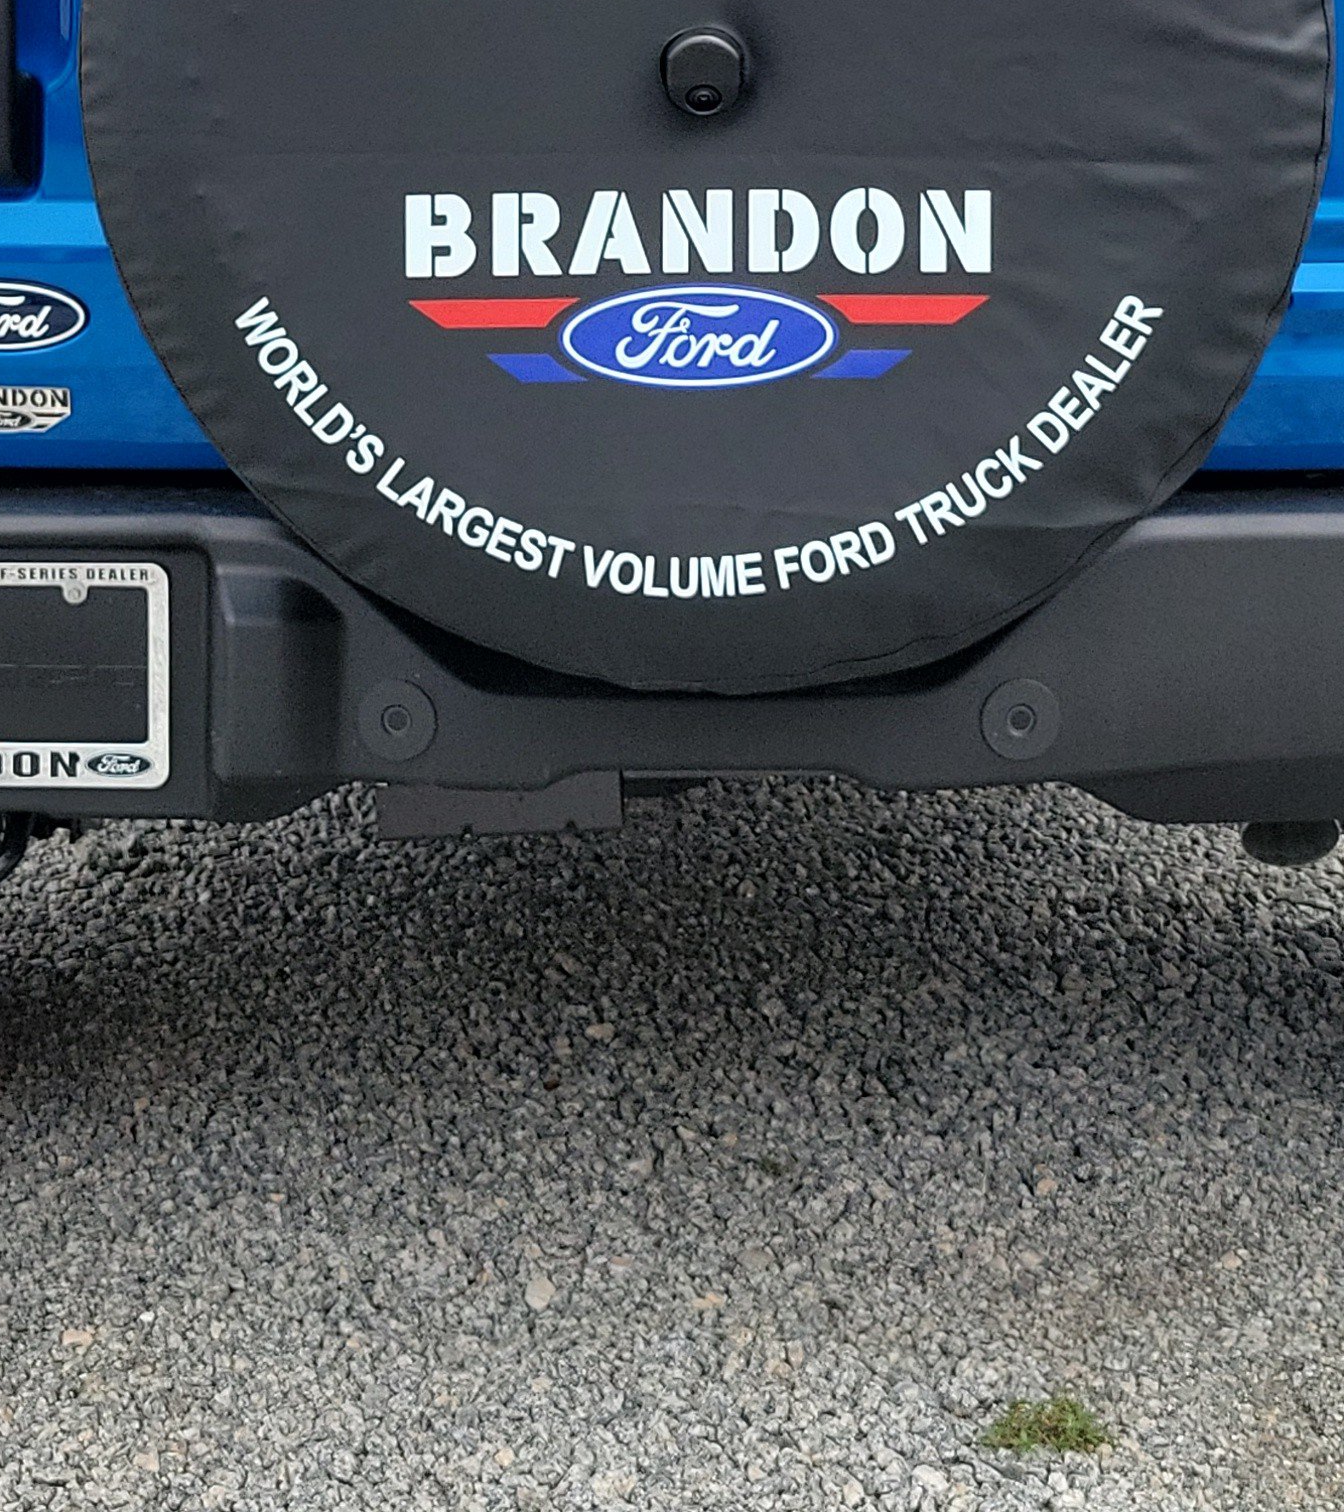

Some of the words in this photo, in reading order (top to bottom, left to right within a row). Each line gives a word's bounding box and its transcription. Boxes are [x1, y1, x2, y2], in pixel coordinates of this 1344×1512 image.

[405, 187, 993, 278] BRANDON
[614, 300, 781, 370] Ford
[375, 456, 577, 579] LARGEST
[582, 544, 767, 599] VOLUME
[772, 520, 897, 592] FORD
[893, 434, 1044, 545] TRUCK
[1025, 294, 1165, 455] DEALER
[0, 567, 78, 581] F-SERIES
[86, 567, 150, 581] DEALER
[97, 755, 140, 773] Ford
